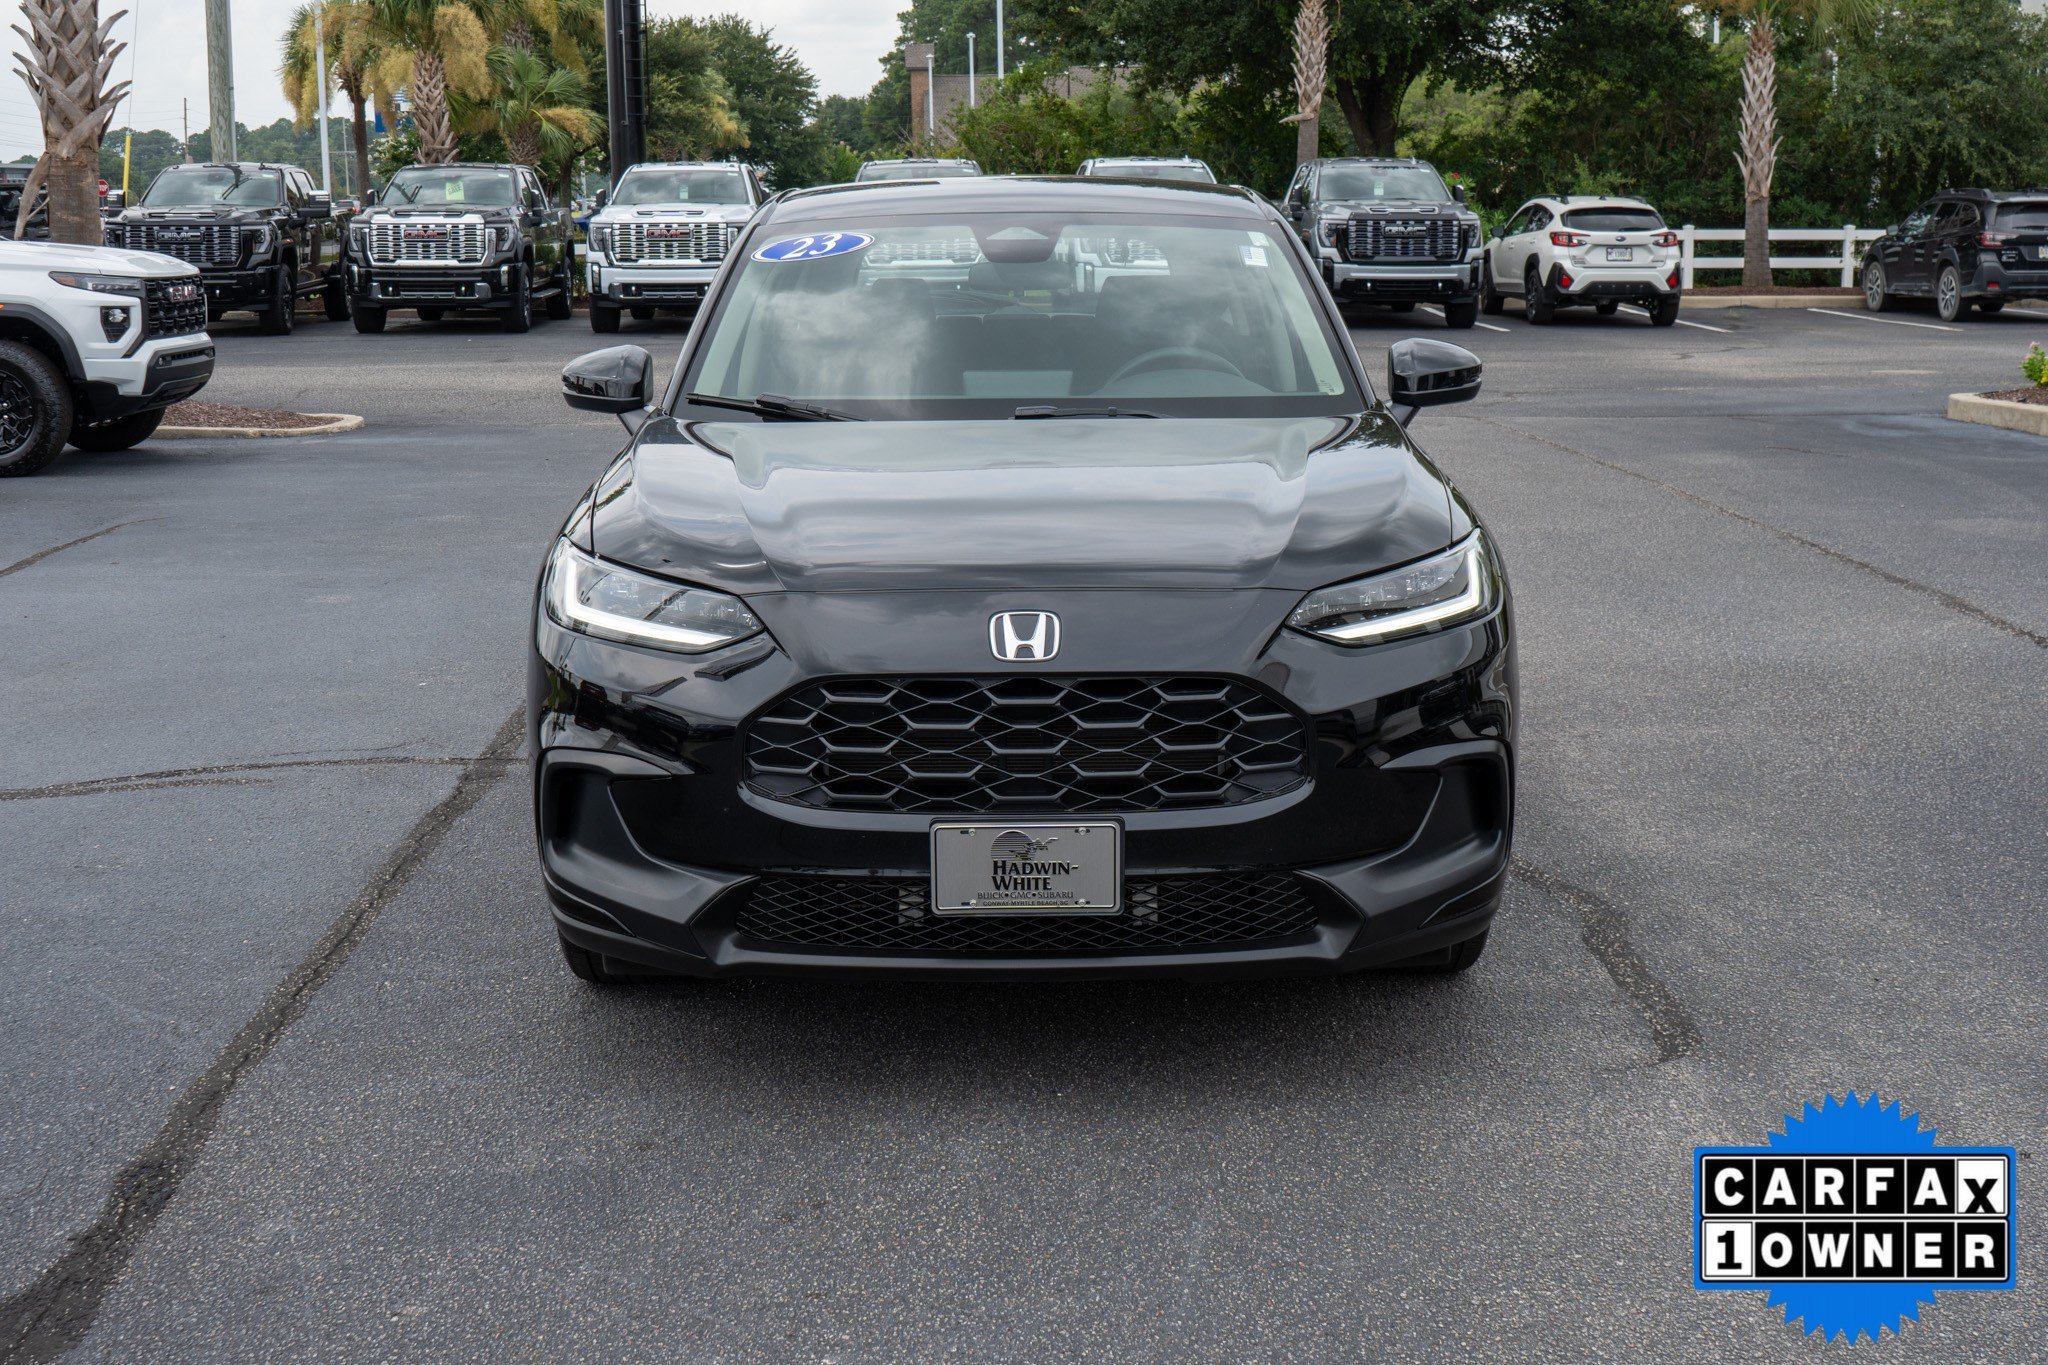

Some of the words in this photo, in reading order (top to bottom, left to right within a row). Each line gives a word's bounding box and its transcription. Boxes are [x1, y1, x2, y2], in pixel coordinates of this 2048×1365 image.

[404, 230, 447, 239] GMC
[647, 229, 690, 239] GMC
[1384, 226, 1427, 236] GMC
[157, 232, 201, 241] GMC
[779, 232, 843, 260] 23
